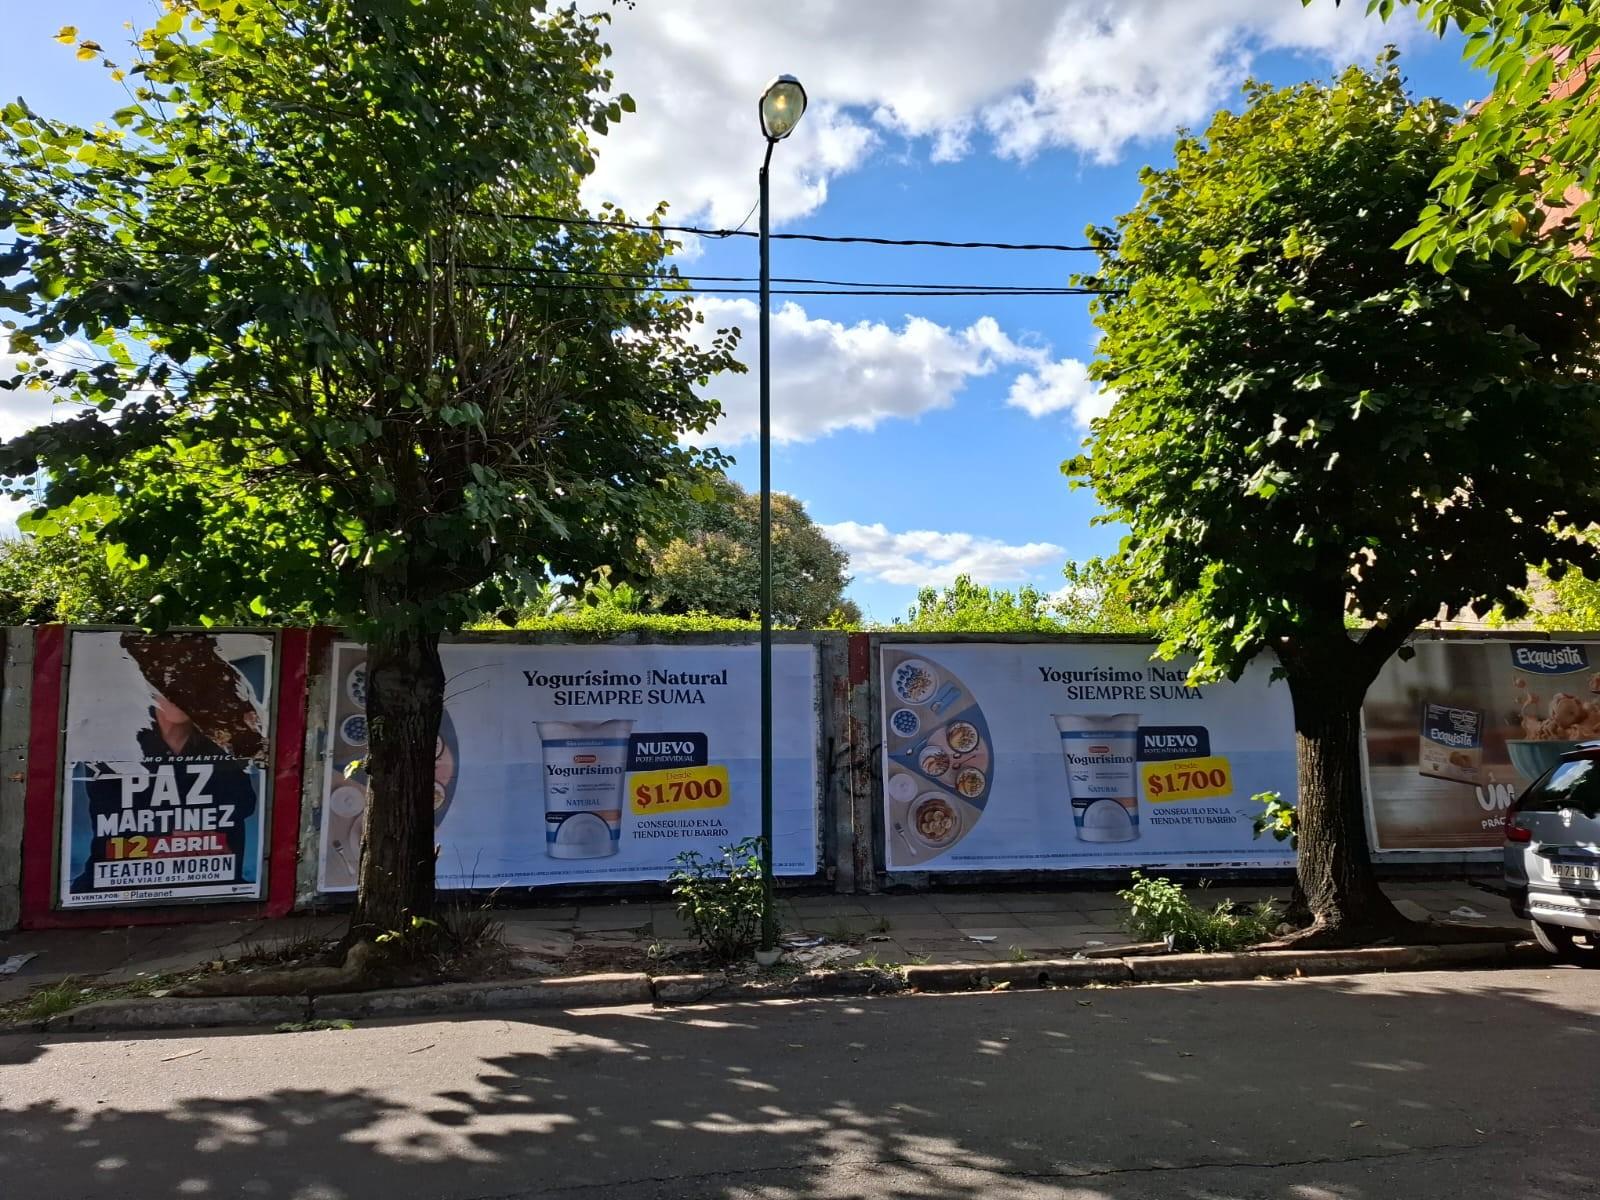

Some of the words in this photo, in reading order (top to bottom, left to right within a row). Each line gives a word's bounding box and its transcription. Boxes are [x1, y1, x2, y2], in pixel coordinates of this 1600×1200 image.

[1517, 646, 1584, 669] Exquisita
[522, 670, 642, 689] Yogurísimo
[651, 669, 728, 686] Natural
[1038, 667, 1143, 684] Yogurísimo
[554, 690, 643, 706] SIEMPRE
[648, 689, 706, 705] SUMA
[1067, 686, 1146, 700] SIEMPRE
[1150, 685, 1203, 700] SUMA
[1144, 735, 1198, 748] NUEVO
[1431, 728, 1473, 747] Exquisita
[637, 741, 695, 755] NUEVO
[1067, 754, 1133, 766] Yogurísimo
[547, 765, 623, 778] Yogurísimo
[121, 764, 214, 808] PAZ
[1148, 768, 1226, 796] $1.700
[636, 778, 722, 808] $1.700
[566, 799, 600, 807] NATURAL
[1152, 808, 1206, 816] CONSEGUILO
[1207, 807, 1218, 815] EN
[1219, 807, 1231, 815] LA
[96, 804, 235, 837] MARTINEZ
[637, 820, 695, 829] CONSEGUILO
[696, 820, 709, 828] EN
[710, 819, 723, 827] LA
[1150, 817, 1180, 825] TIENDA
[1181, 817, 1193, 825] DE
[1193, 816, 1205, 824] TU
[1206, 816, 1237, 824] BARRIO
[1481, 815, 1506, 829] PRÁC
[632, 830, 667, 839] TIENDA
[667, 829, 680, 838] DE
[681, 829, 694, 837] TU
[694, 828, 729, 837] BARRIO
[111, 835, 148, 860] 12
[153, 835, 223, 854] ABRIL
[98, 861, 165, 879] TEATRO
[172, 856, 233, 874] MORON
[110, 878, 135, 886] BUEN
[137, 876, 164, 884] VIAJE
[187, 873, 220, 881] MORÓN
[130, 890, 173, 899] Plateanet
